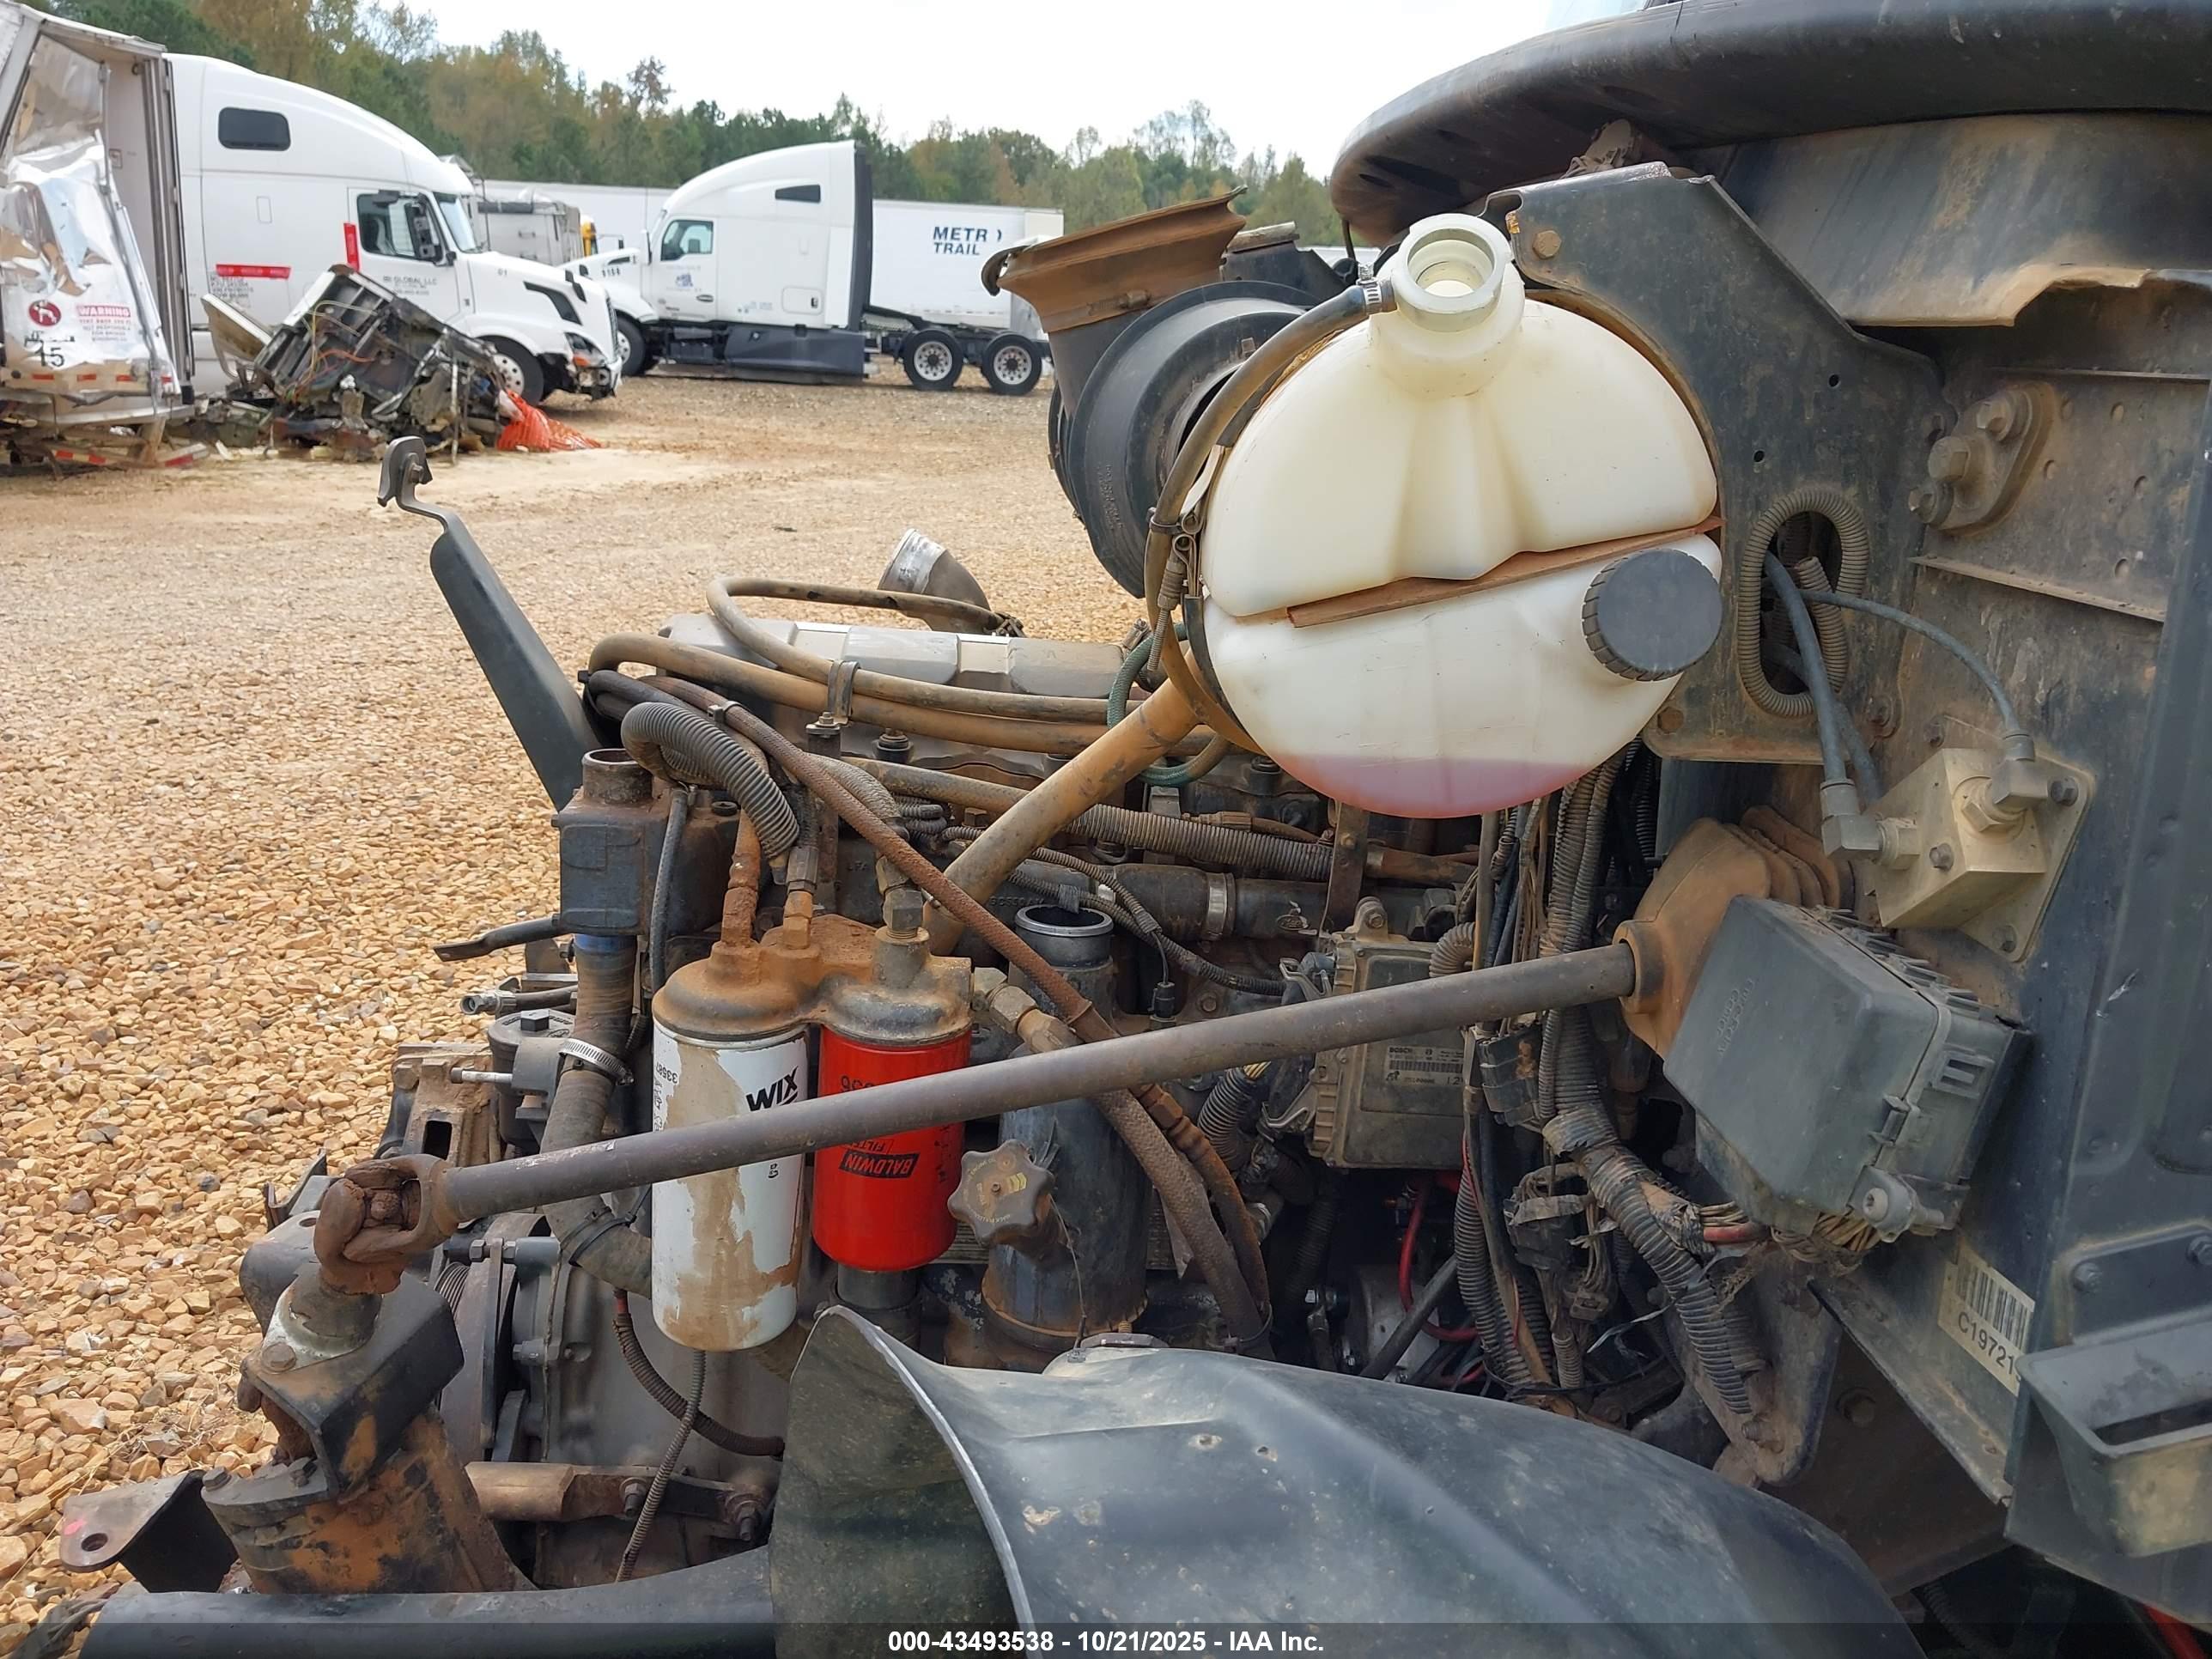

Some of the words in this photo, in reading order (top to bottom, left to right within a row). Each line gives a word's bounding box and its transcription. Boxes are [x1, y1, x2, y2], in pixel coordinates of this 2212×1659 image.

[933, 241, 981, 256] TRAIL
[78, 305, 130, 317] WARNING
[745, 1066, 799, 1112] WIX
[844, 1152, 914, 1176] BALDWIN
[1958, 1310, 2022, 1382] C19721
